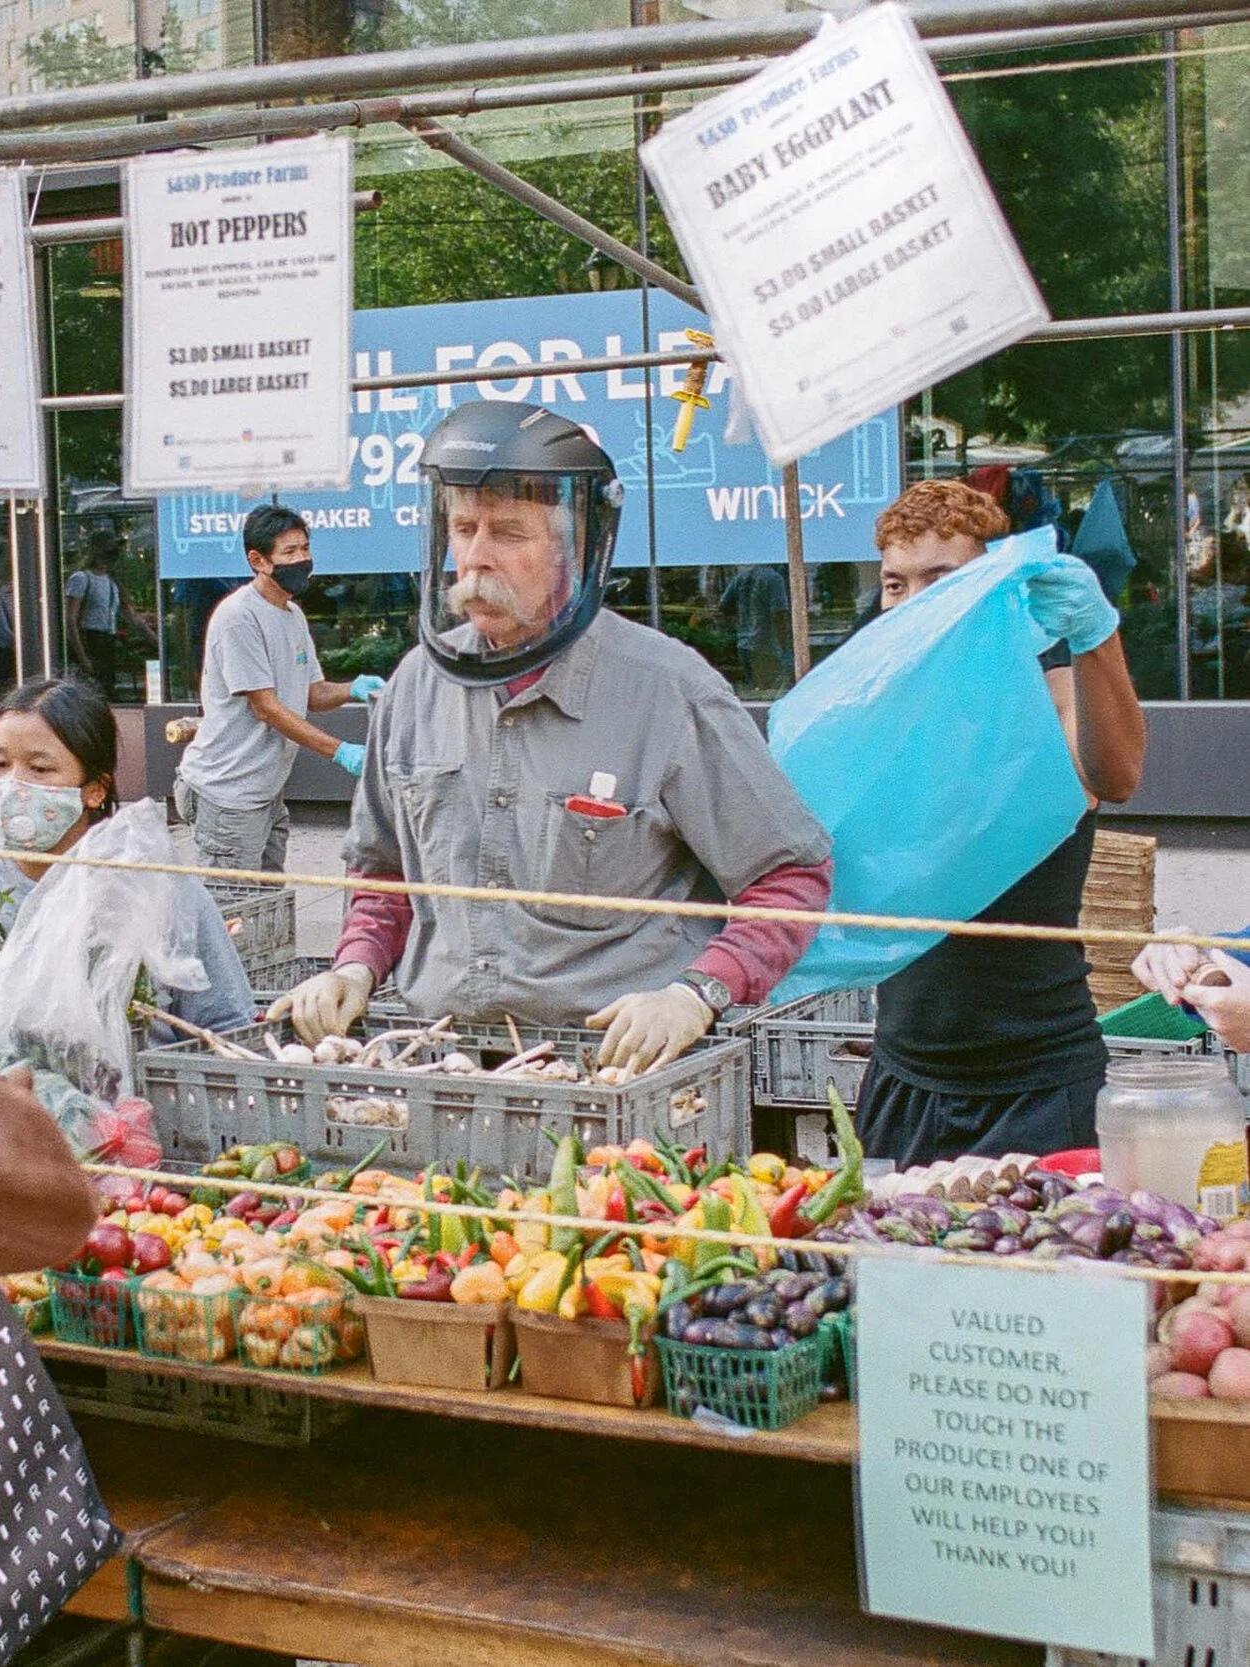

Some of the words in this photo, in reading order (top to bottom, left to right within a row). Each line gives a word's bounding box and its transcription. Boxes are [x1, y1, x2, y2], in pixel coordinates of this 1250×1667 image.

[741, 78, 808, 125] Produce
[705, 154, 771, 211] BABY
[772, 77, 896, 169] EGGPLANT
[205, 170, 262, 192] Produce
[266, 165, 308, 183] Farms
[170, 219, 210, 249] HOT
[217, 210, 308, 244] PEPPERS
[754, 262, 807, 304] $3.00
[807, 227, 869, 273] SMALL
[868, 182, 939, 237] BASKET
[769, 295, 824, 338] $5.00
[824, 261, 882, 306] LARGE
[882, 218, 953, 273] BASKET
[169, 347, 208, 365] $3.00
[212, 344, 254, 362] SMALL
[258, 338, 312, 358] BASKET
[169, 379, 209, 398] $5.00
[212, 376, 253, 395] LARGE
[256, 372, 310, 392] BASKET
[434, 337, 597, 410] FOR
[951, 1309, 1045, 1336] VALUED
[928, 1341, 1068, 1376] CUSTOMER,
[909, 1372, 989, 1400] PLEASE
[997, 1382, 1033, 1405] DO
[1040, 1387, 1092, 1410] NOT
[933, 1408, 1014, 1438] TOUCH
[1020, 1418, 1068, 1444] THE
[894, 1437, 1012, 1470] PRODUCE!
[1019, 1453, 1070, 1478] ONE
[1077, 1460, 1110, 1481] OF
[904, 1472, 955, 1496] OUR
[961, 1480, 1100, 1516] EMPLOYEES
[911, 1505, 967, 1531] WILL
[971, 1514, 1029, 1537] HELP
[1035, 1524, 1096, 1547] YOU!
[932, 1539, 1011, 1568] THANK
[1017, 1552, 1077, 1577] YOU!
